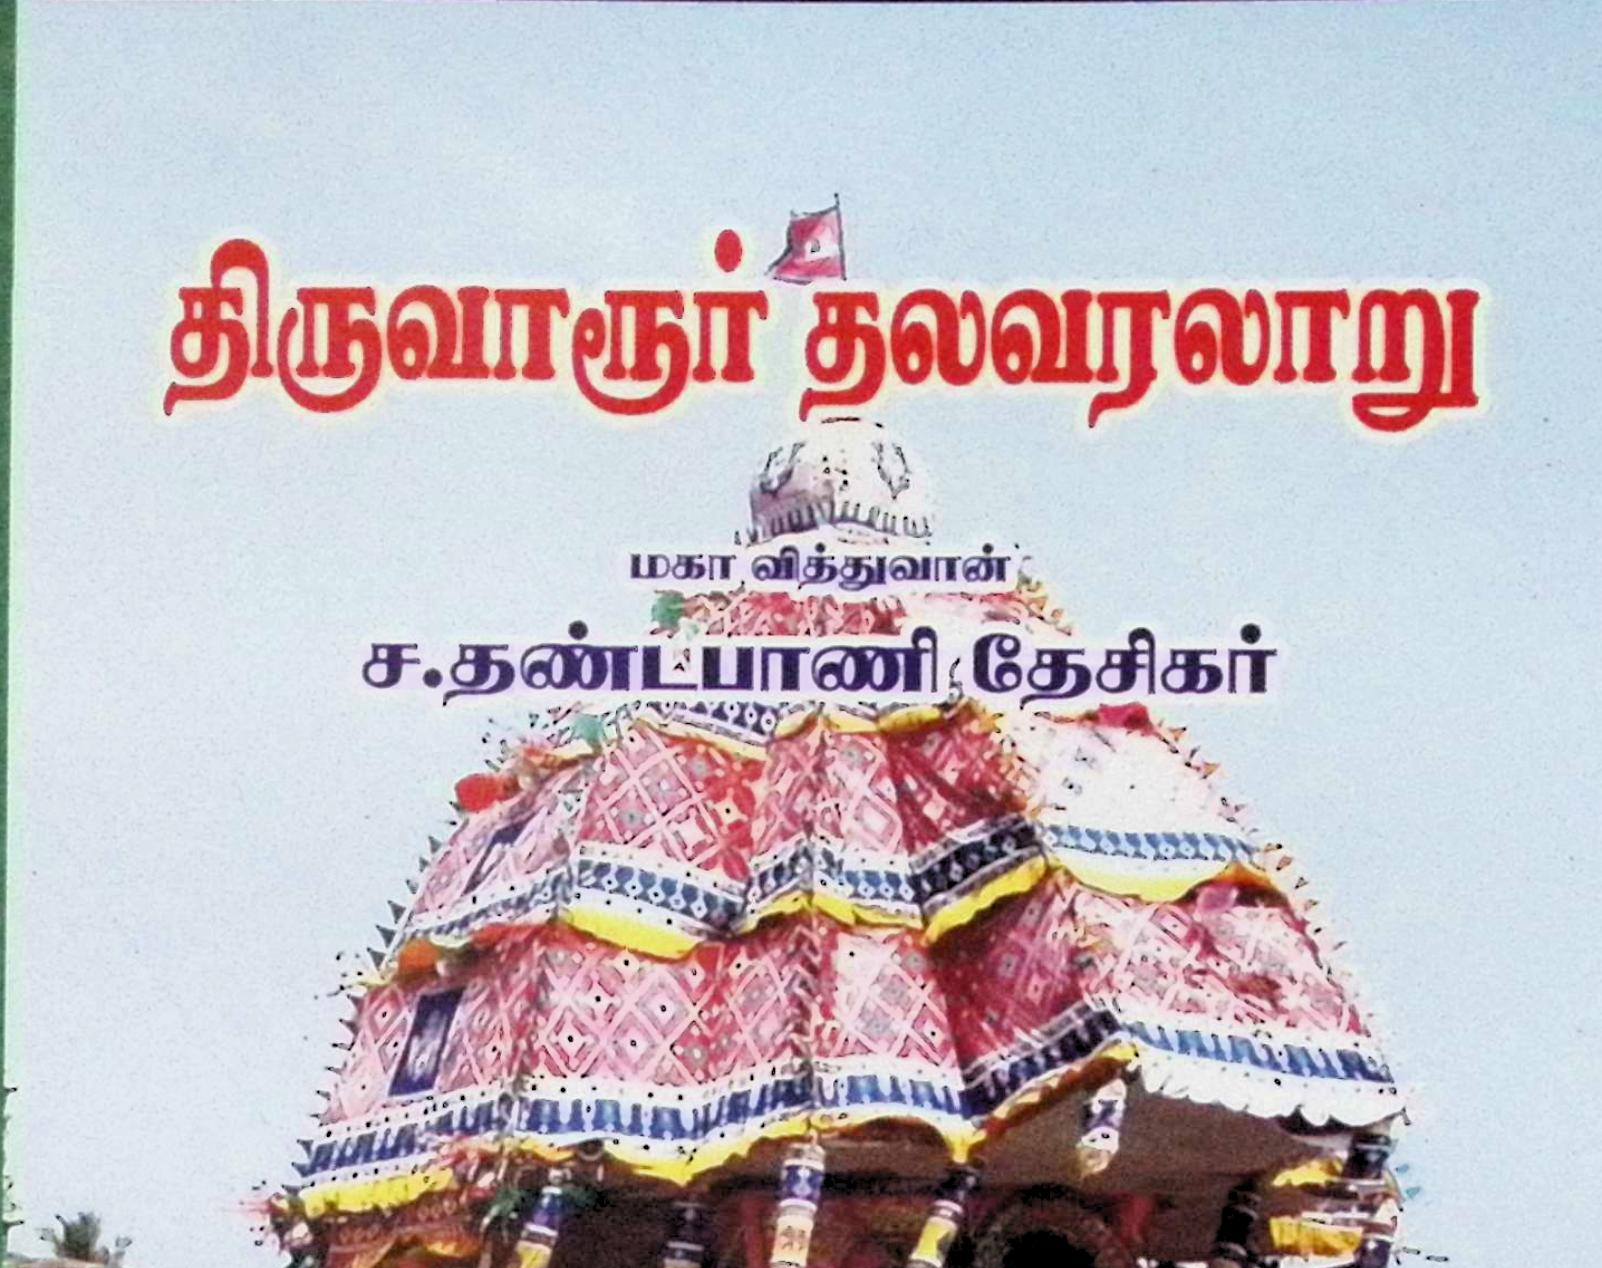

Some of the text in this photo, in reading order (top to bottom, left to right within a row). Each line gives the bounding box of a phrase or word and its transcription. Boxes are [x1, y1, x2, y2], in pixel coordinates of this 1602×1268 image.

[166, 232, 1479, 431] திருவாரூர் தலவரலாறு
[630, 543, 1010, 591] மகா வித்துவான்
[362, 620, 1277, 710] ச.தண்டபாணி தேசிகர்
